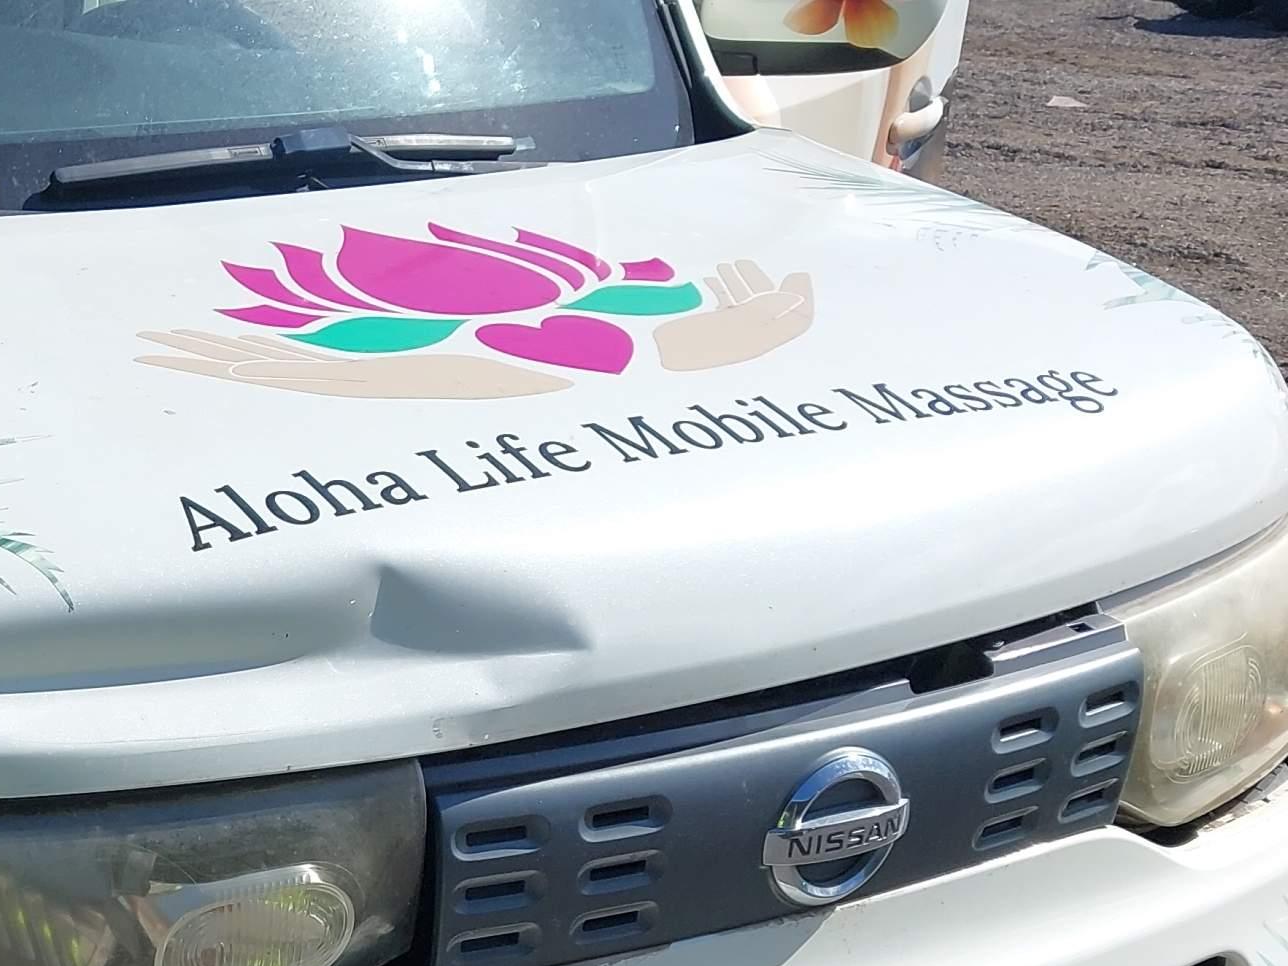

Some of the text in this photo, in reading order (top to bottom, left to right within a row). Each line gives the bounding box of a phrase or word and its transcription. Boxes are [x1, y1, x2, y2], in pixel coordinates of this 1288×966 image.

[178, 368, 1118, 552] Aloha Life Mobile Massage
[787, 814, 901, 858] NISSAN
